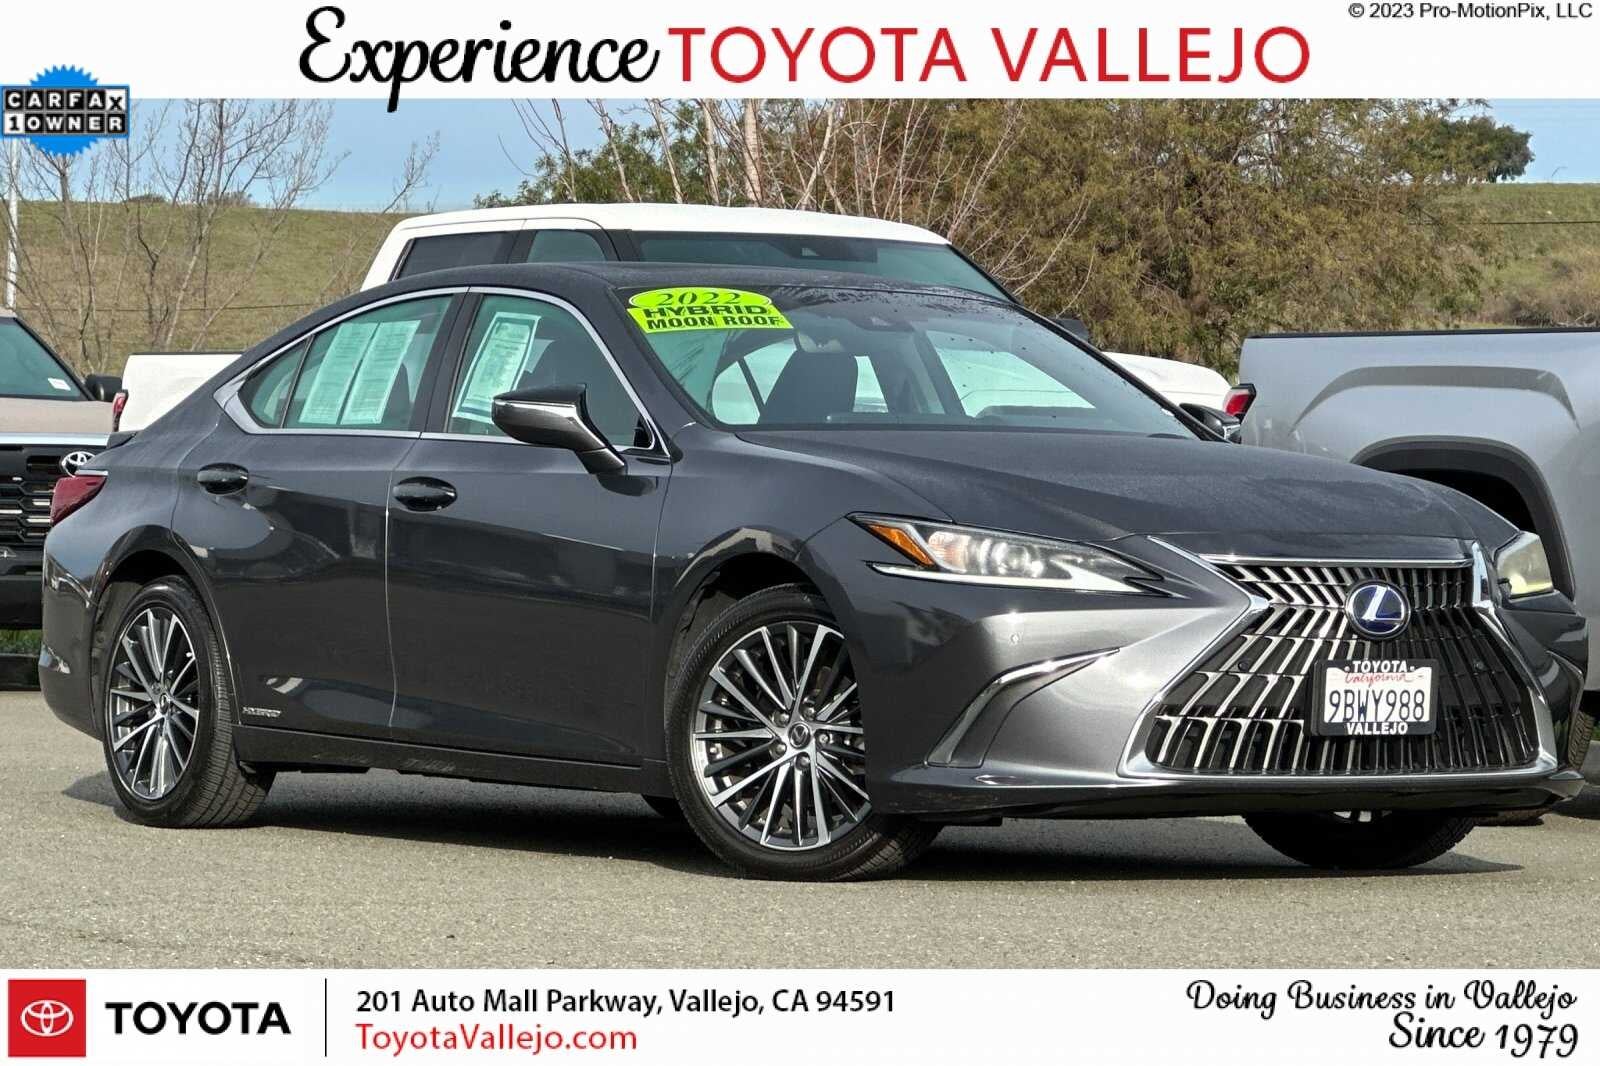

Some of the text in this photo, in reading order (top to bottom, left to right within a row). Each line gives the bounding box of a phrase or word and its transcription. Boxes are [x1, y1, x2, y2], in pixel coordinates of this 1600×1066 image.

[658, 292, 741, 305] 2022
[643, 305, 768, 318] HYBRID
[646, 316, 783, 329] MOON ROOF
[1352, 660, 1408, 673] TOYOTA
[1328, 689, 1425, 722] 9BWY988
[1346, 722, 1408, 735] VALLEJO
